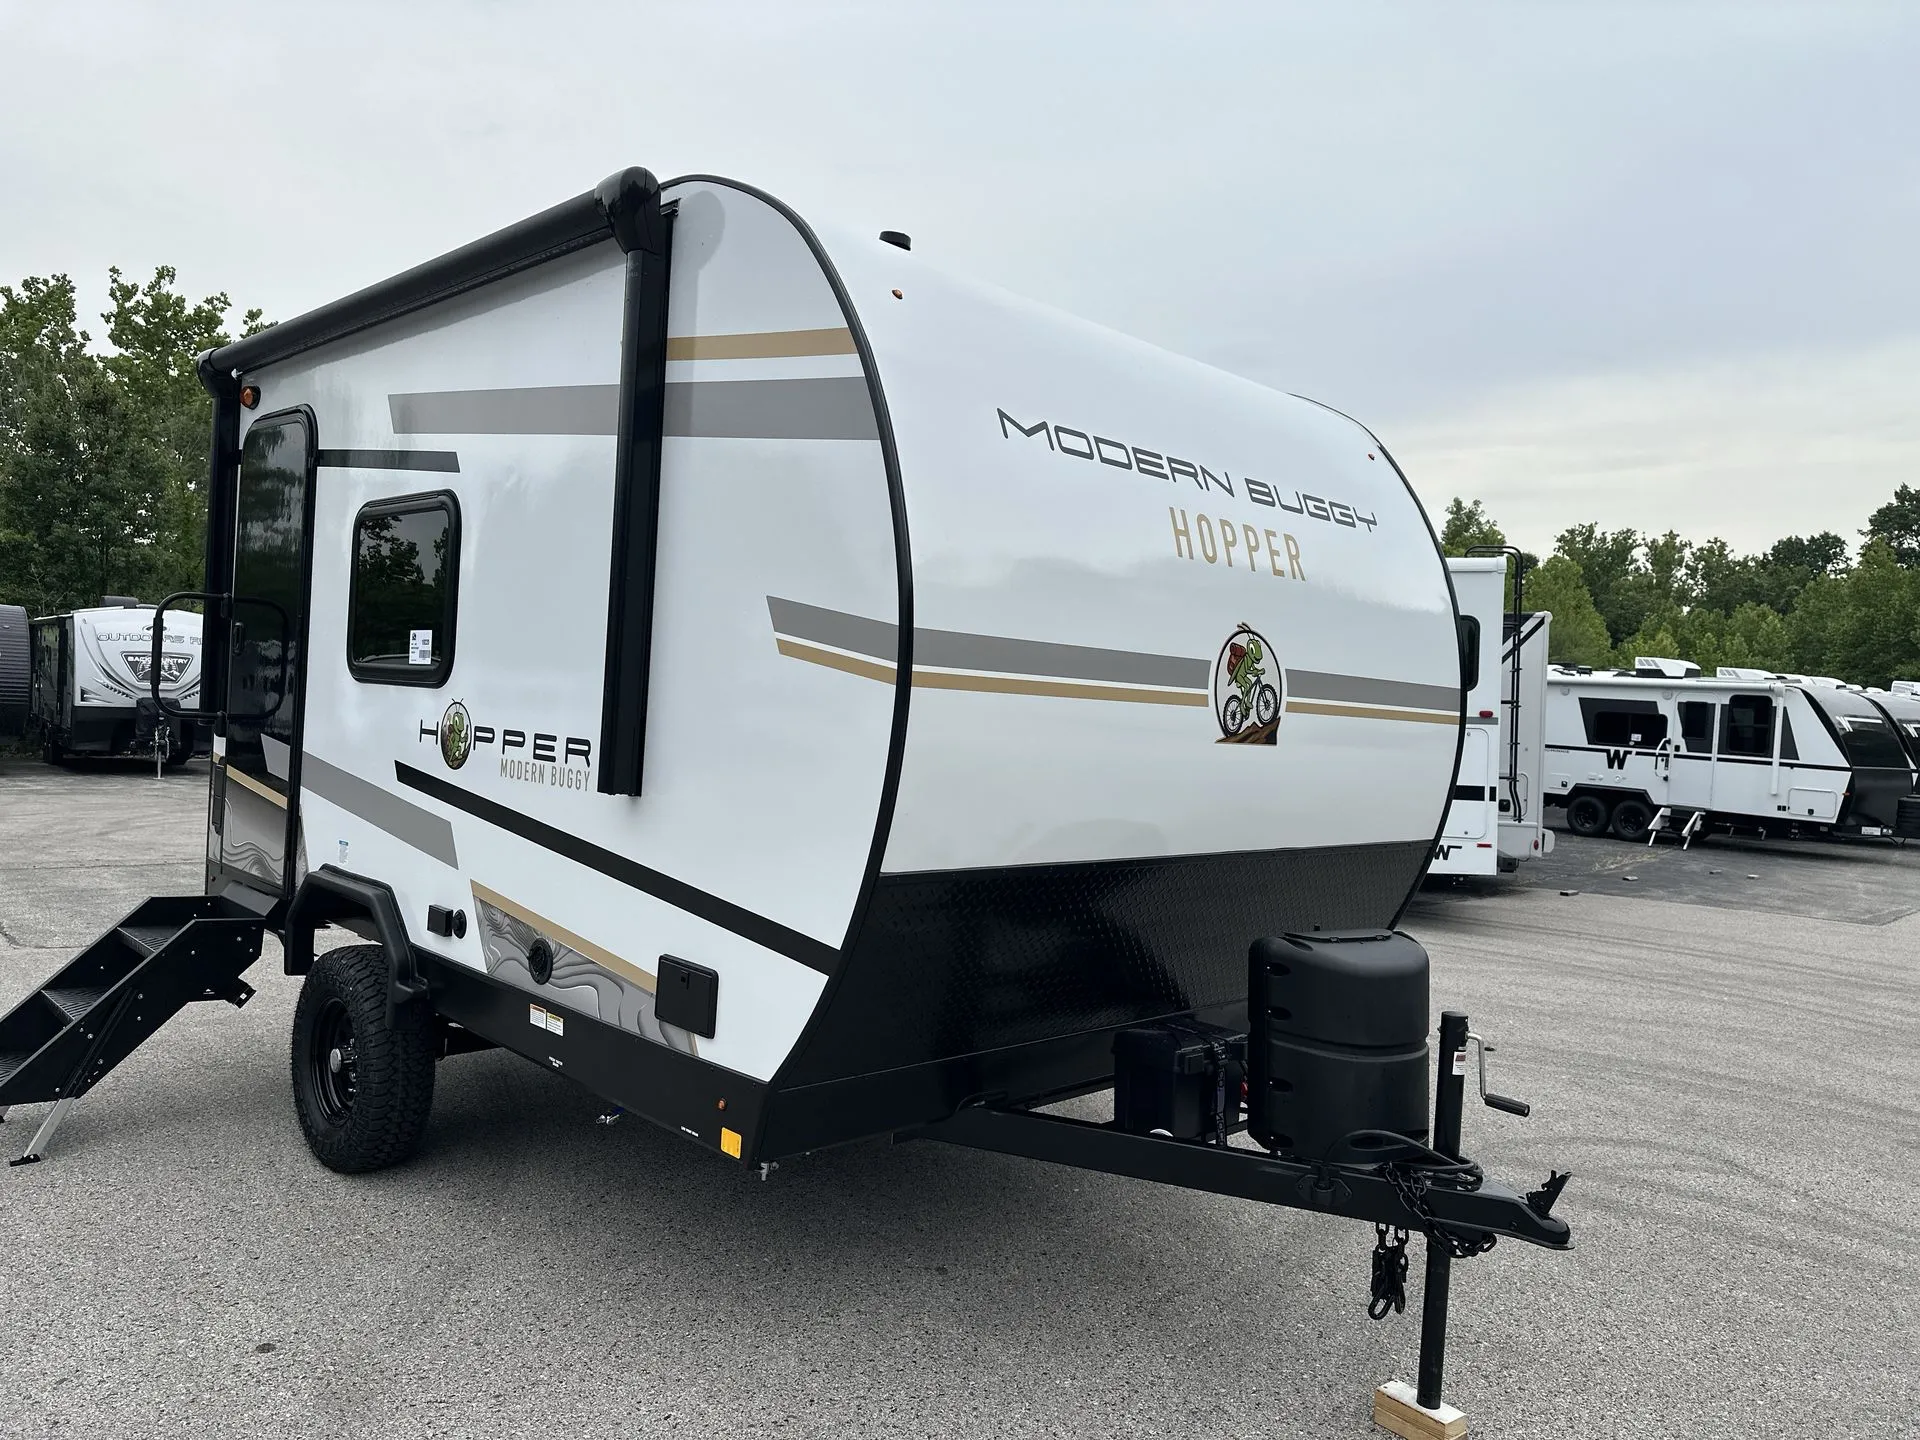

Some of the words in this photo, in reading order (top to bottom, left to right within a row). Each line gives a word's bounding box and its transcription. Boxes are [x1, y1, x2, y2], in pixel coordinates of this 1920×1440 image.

[997, 408, 1235, 498] MODERN
[1245, 478, 1378, 533] BUGGY
[1169, 506, 1306, 582] HOPPER
[97, 633, 185, 644] OUTDORS
[500, 758, 546, 785] MODERN
[551, 766, 591, 791] BUGGY
